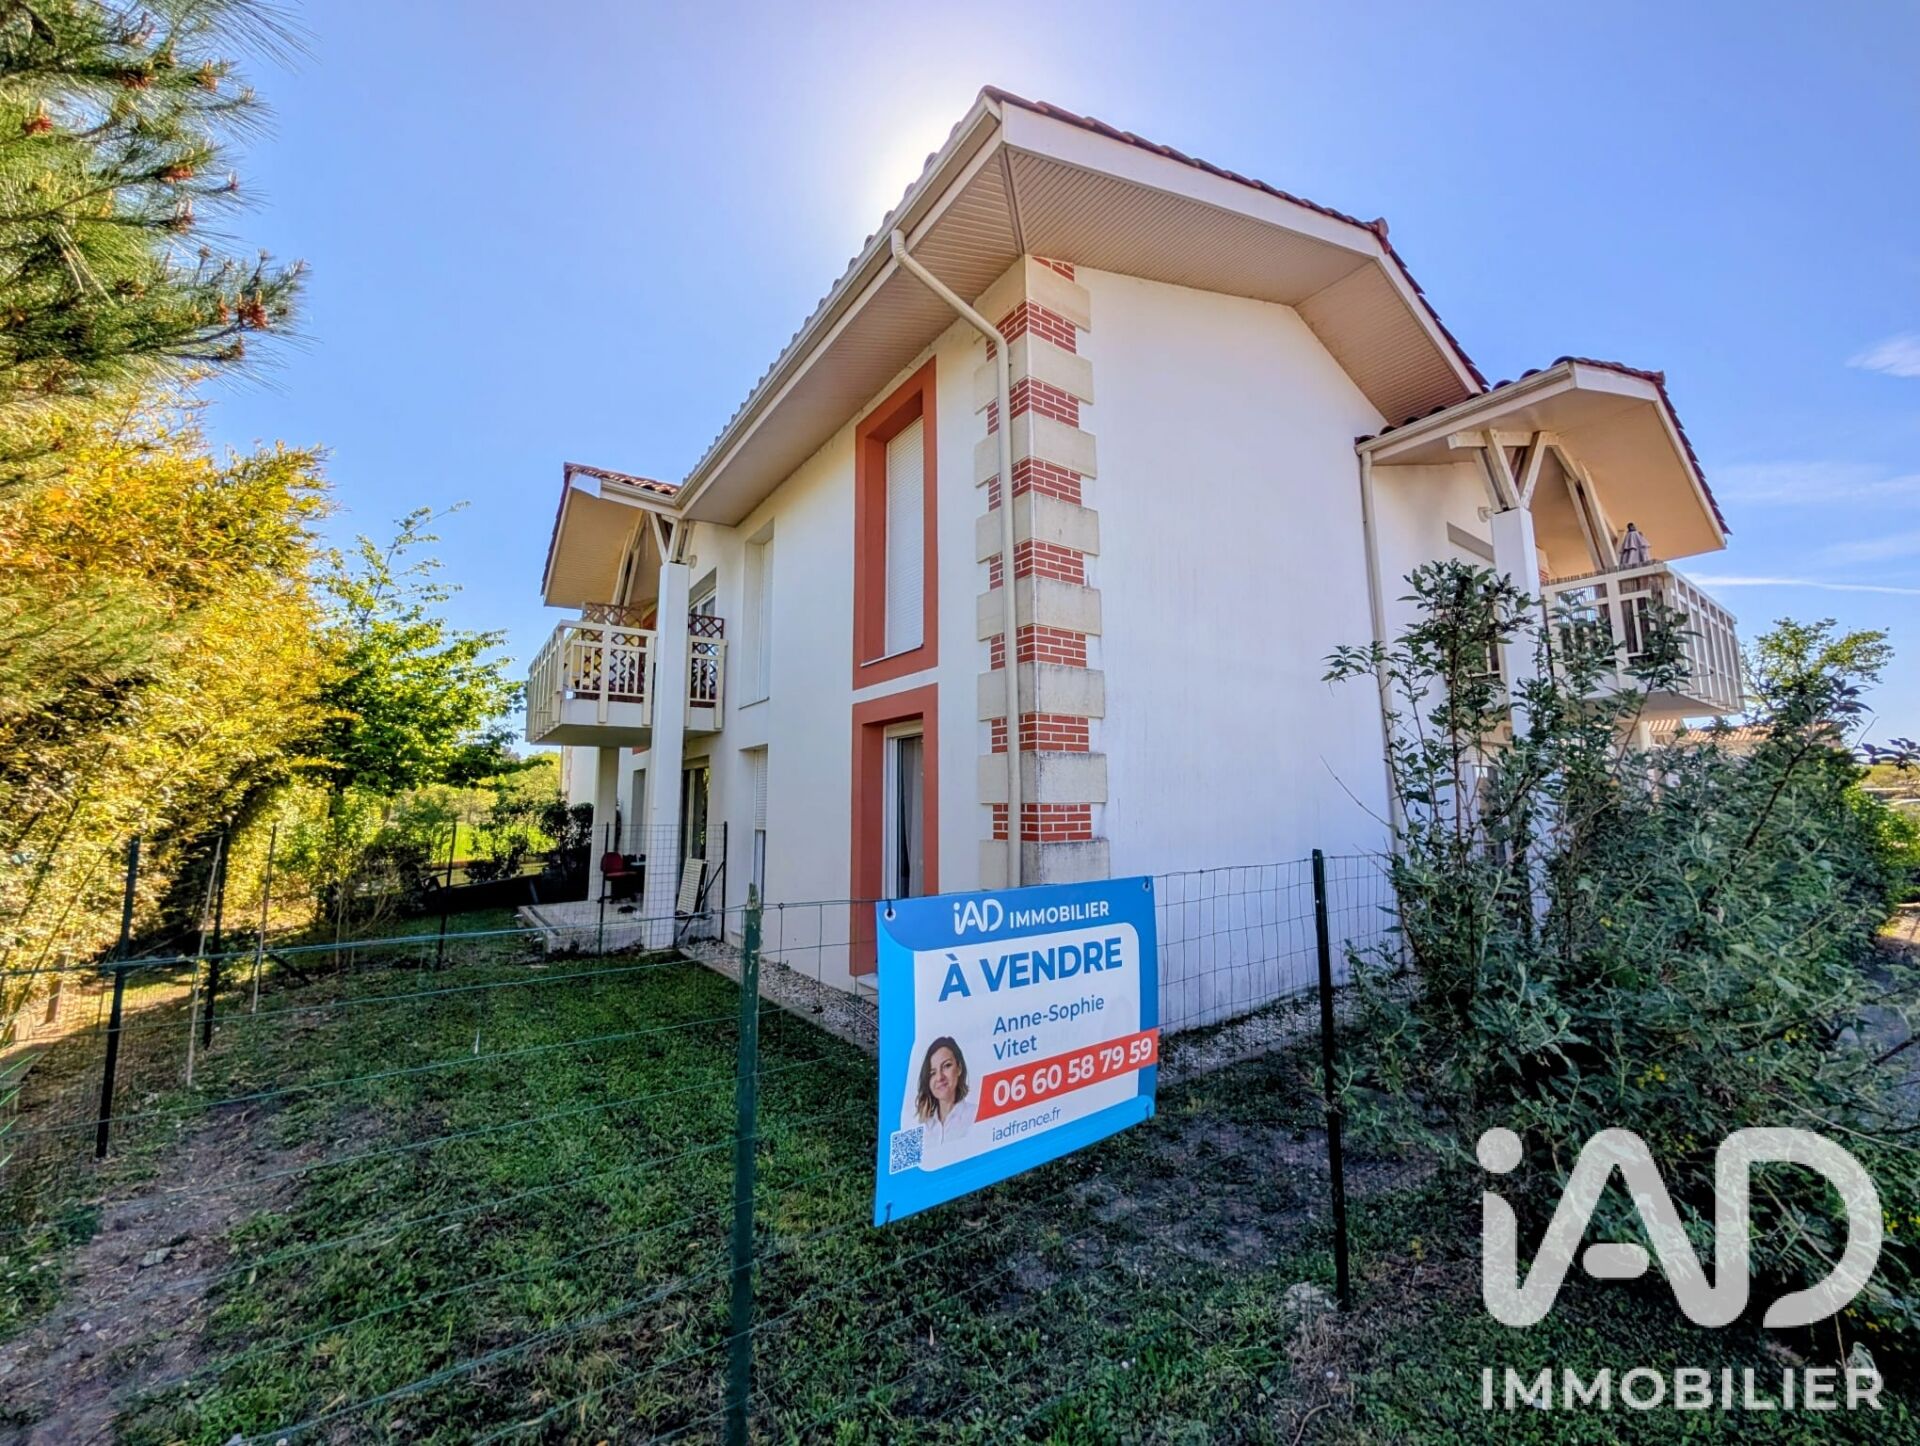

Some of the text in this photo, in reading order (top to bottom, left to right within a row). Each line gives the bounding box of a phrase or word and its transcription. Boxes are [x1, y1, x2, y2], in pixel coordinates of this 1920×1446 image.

[1009, 901, 1109, 929] IMMOBILIER
[938, 937, 1123, 1002] À VENDRE
[993, 994, 1105, 1036] Anne-Sophie
[993, 1034, 1037, 1060] Vitet
[993, 1037, 1152, 1107] 06 60 58 79 59
[991, 1107, 1061, 1142] iadfrance.fr
